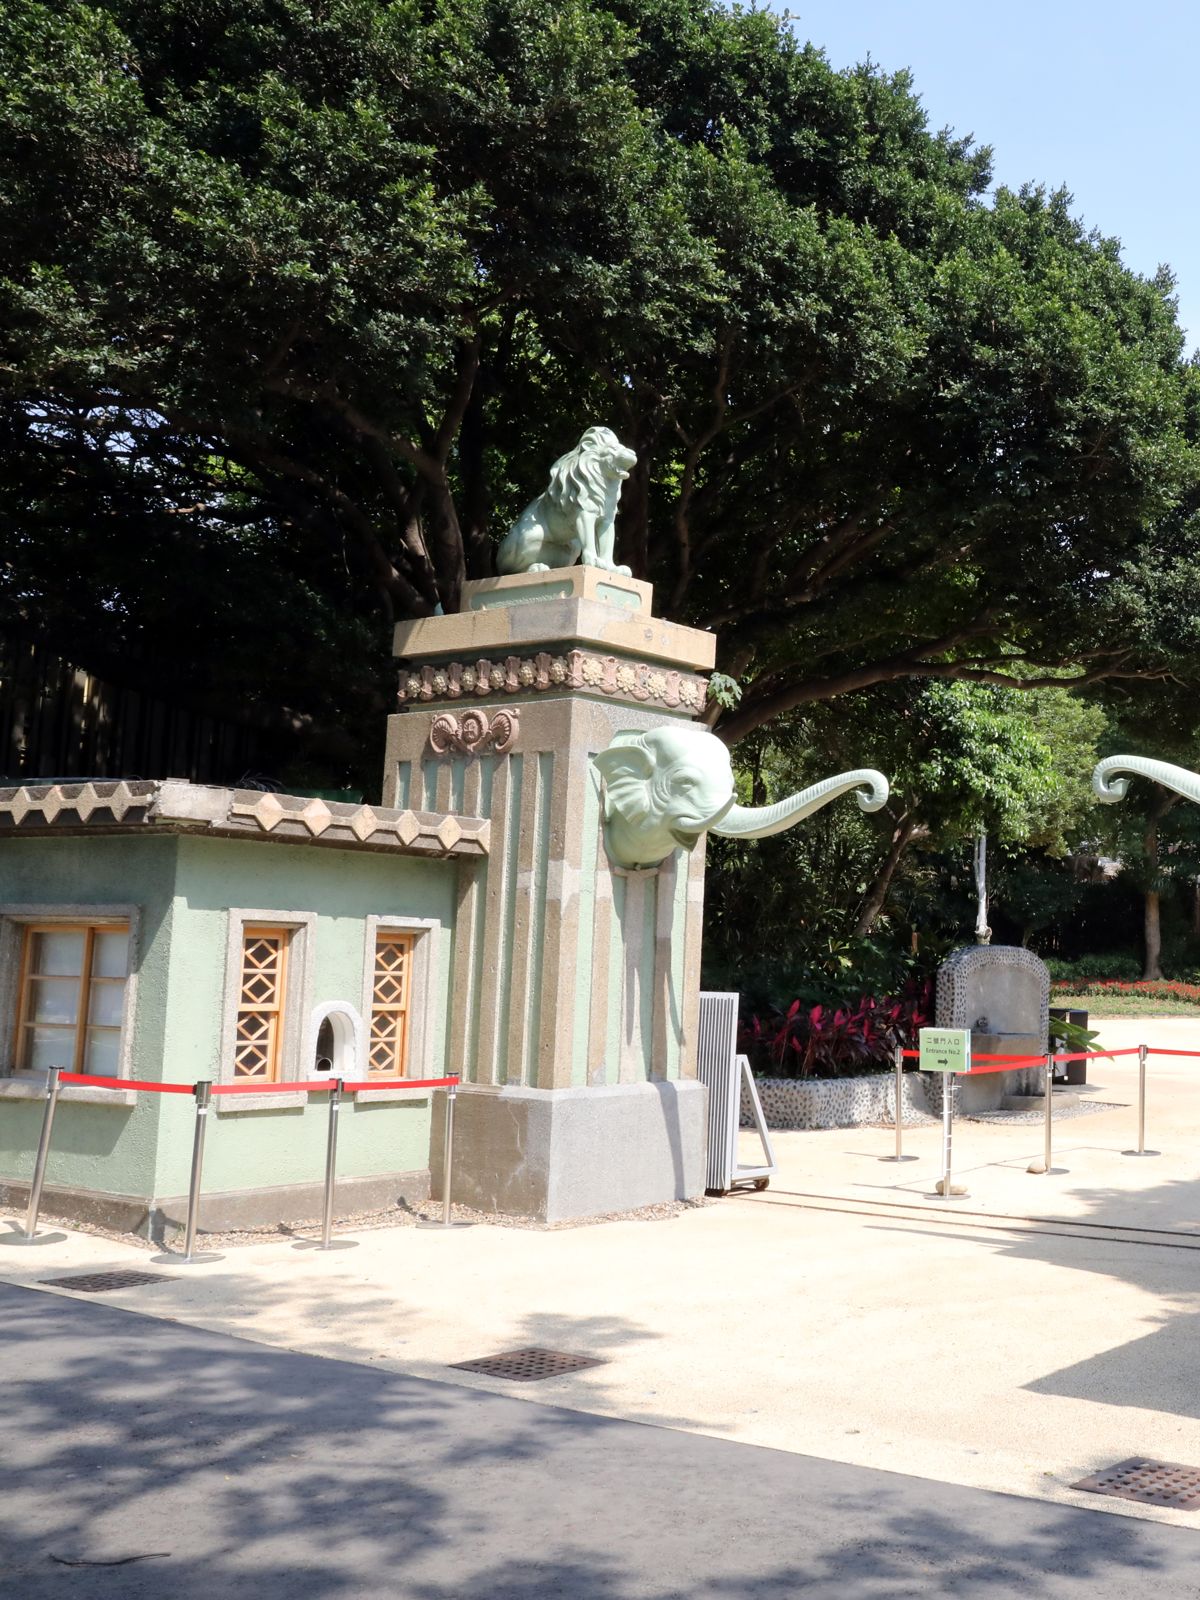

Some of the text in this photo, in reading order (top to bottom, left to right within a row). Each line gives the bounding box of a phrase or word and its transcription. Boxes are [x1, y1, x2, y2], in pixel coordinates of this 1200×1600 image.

[927, 1037, 960, 1046] 二號門入口
